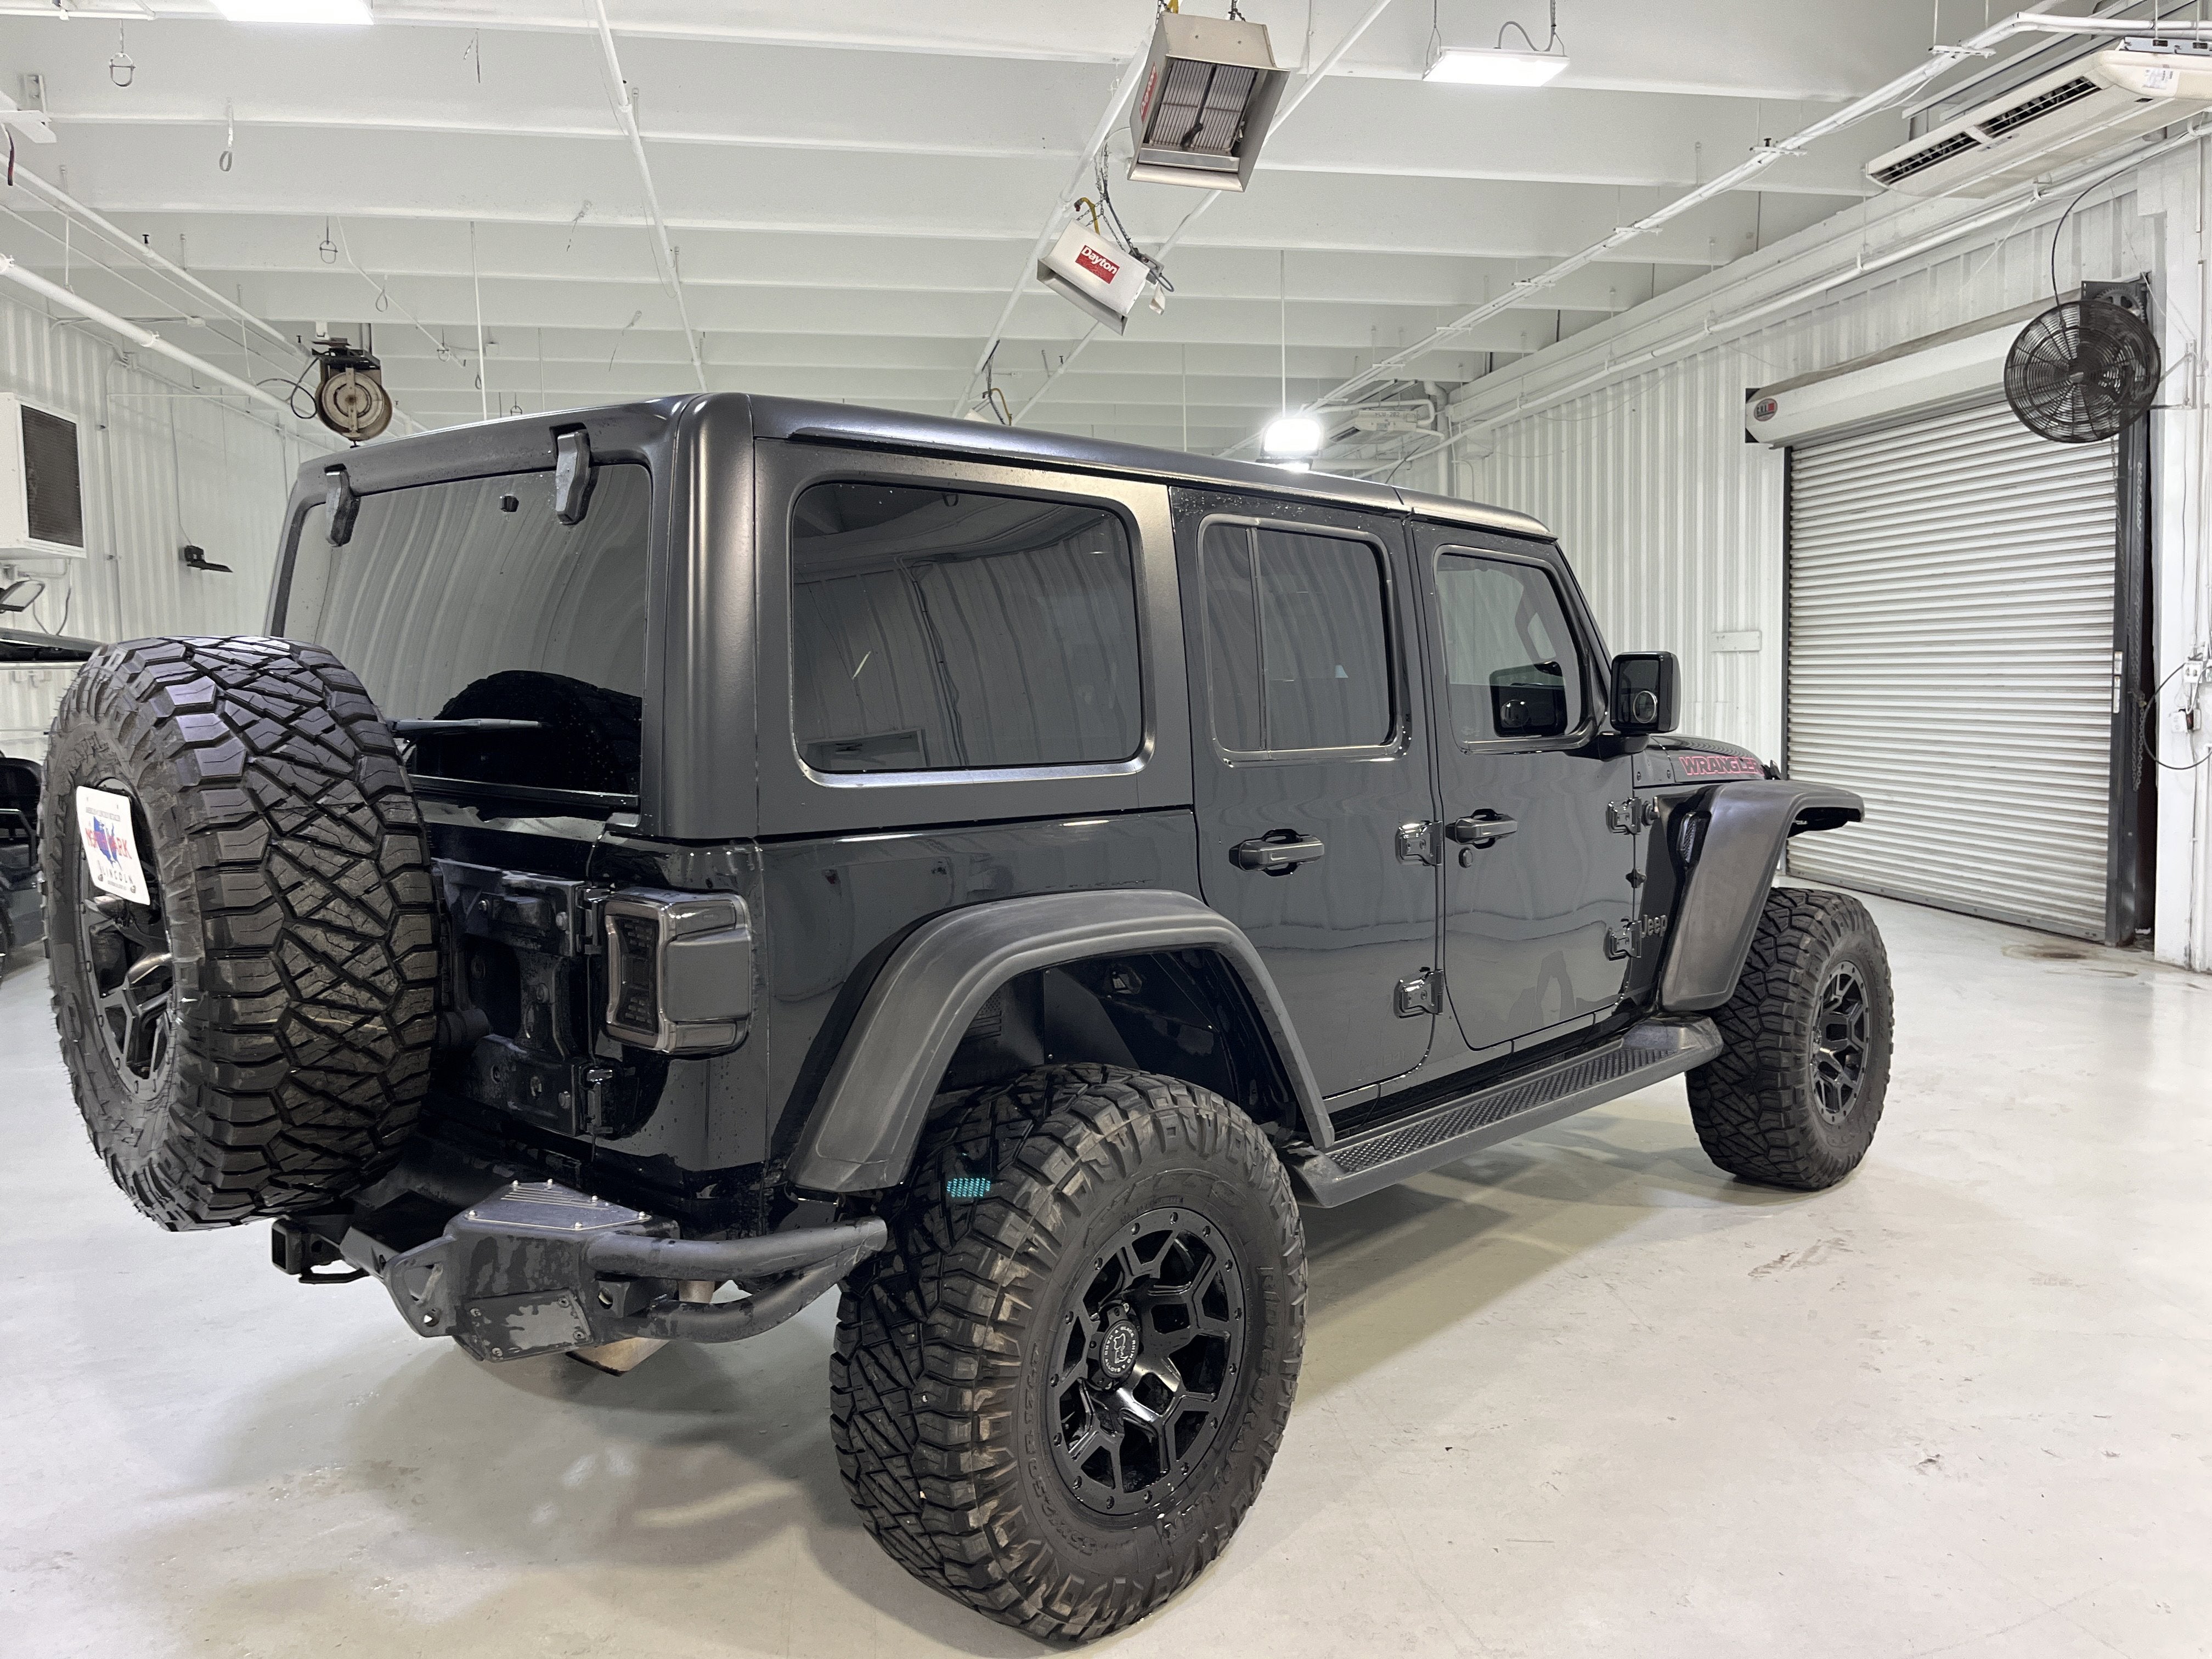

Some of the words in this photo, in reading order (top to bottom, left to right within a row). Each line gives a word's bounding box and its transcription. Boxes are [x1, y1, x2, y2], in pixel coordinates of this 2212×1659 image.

[1081, 246, 1118, 274] Dayton
[1678, 756, 1765, 776] WRANGLER
[102, 866, 133, 884] LINCOLN
[1641, 915, 1668, 938] Jeep
[1126, 1340, 1136, 1364] RHINO
